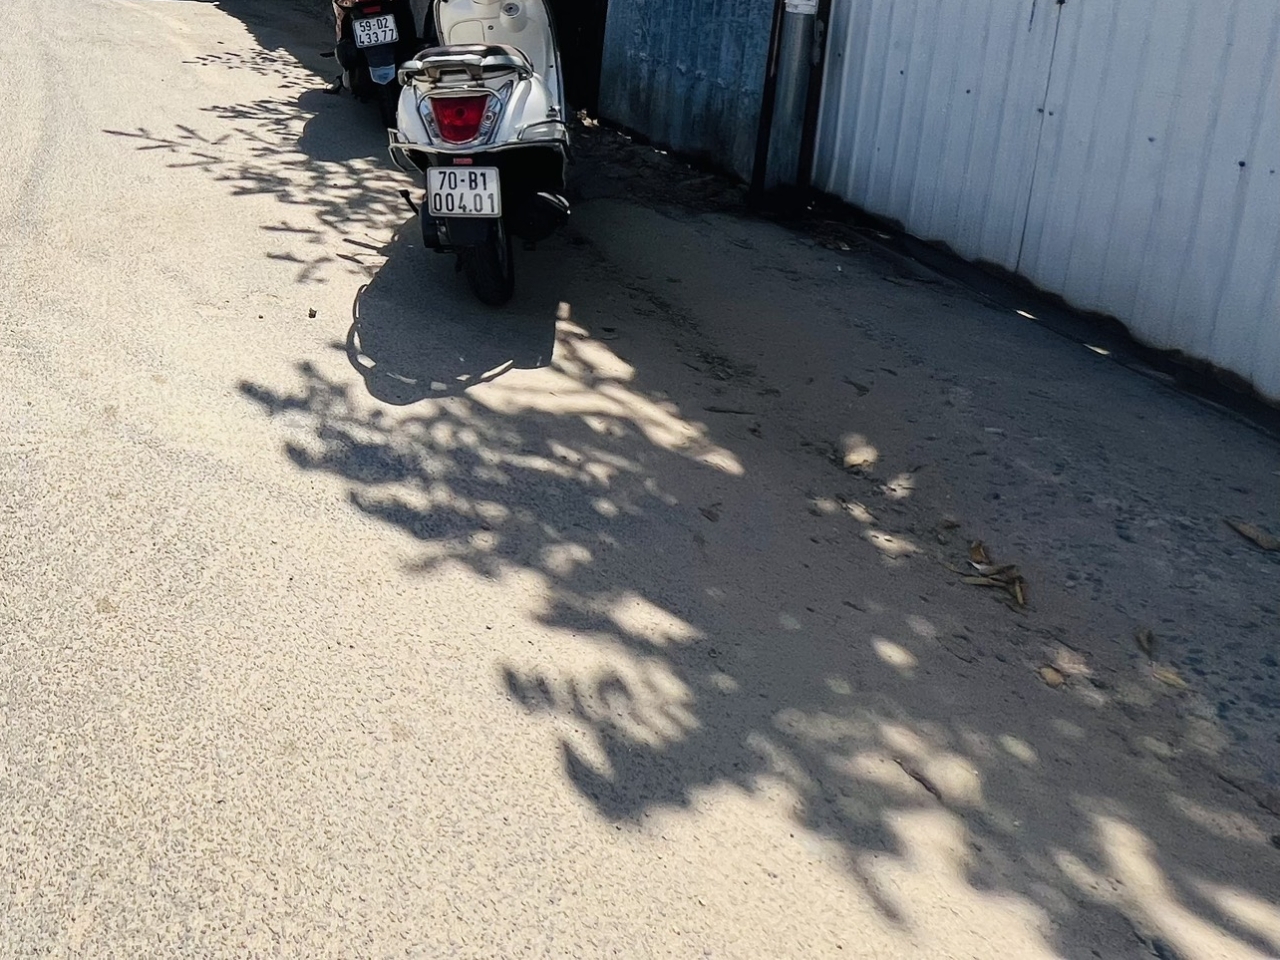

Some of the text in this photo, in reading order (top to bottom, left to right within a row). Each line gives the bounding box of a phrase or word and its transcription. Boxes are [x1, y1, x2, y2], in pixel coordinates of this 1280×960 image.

[359, 17, 390, 33] 59-D2
[438, 171, 487, 191] 70-B1
[433, 192, 495, 213] 004.01
